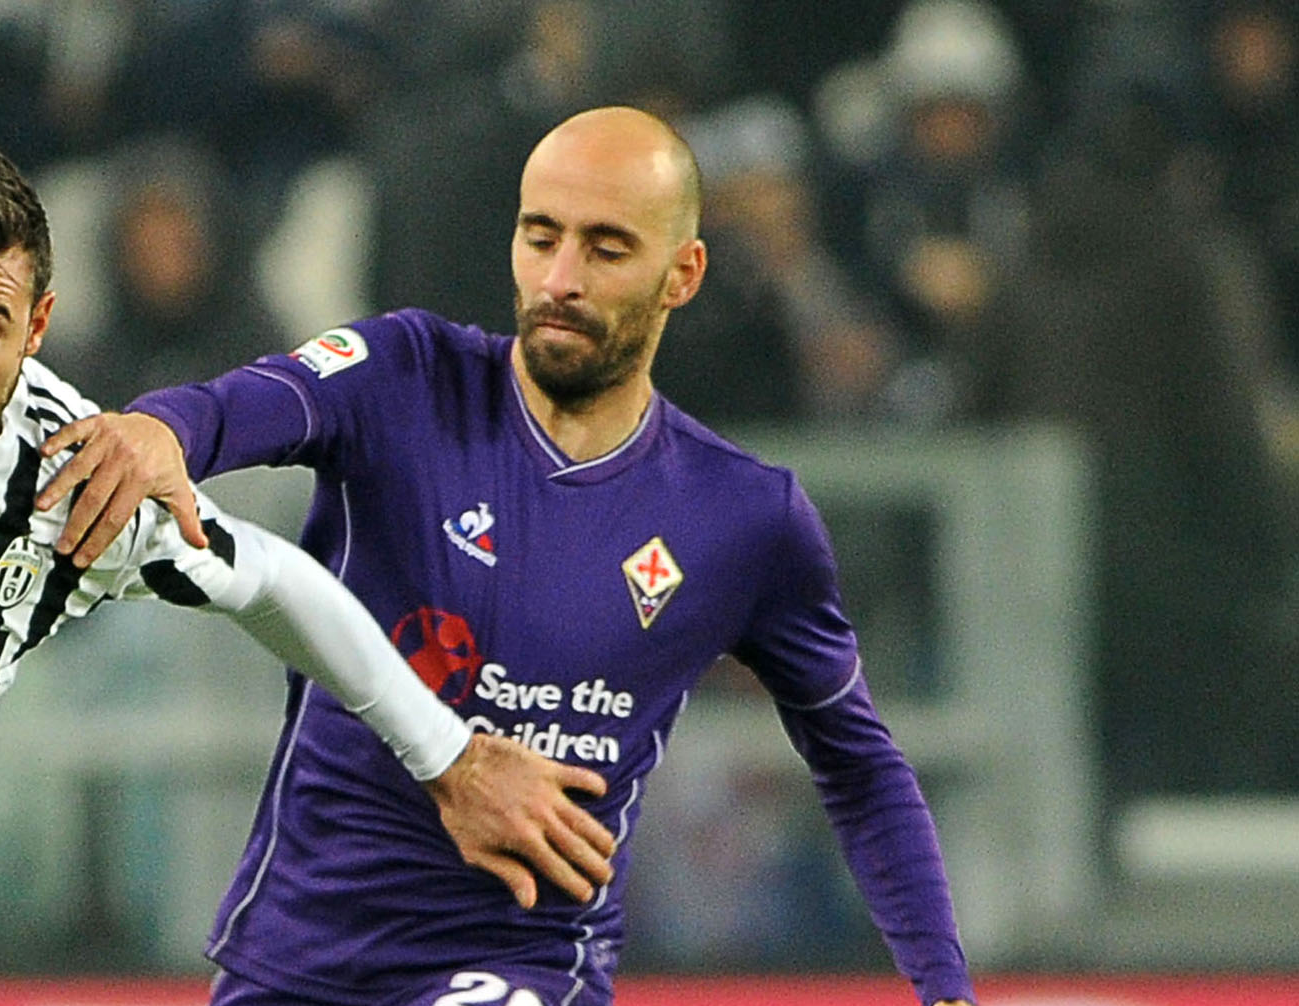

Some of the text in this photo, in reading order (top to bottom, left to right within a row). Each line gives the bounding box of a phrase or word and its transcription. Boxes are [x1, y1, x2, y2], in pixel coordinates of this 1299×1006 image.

[475, 663, 634, 718] Save the
[465, 715, 620, 764] ildren
